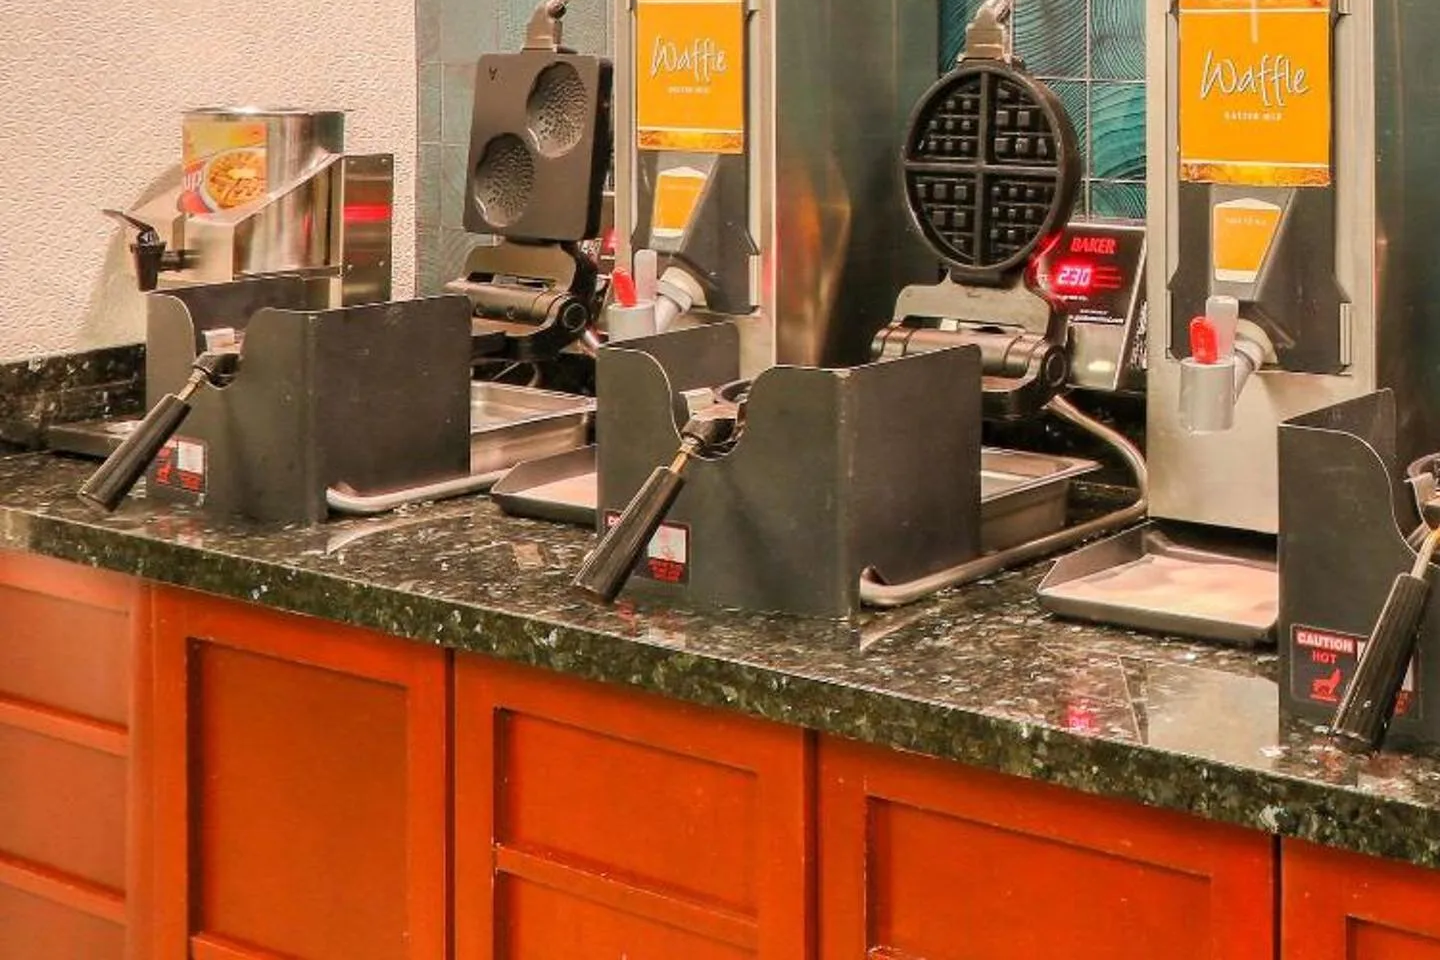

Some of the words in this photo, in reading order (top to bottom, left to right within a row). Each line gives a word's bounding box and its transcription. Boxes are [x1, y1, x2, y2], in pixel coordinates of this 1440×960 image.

[650, 33, 728, 84] Waffle
[1200, 49, 1309, 107] Waffle
[1071, 237, 1116, 255] BAKER
[1296, 632, 1355, 654] CAUTION
[1312, 651, 1337, 665] HOT
